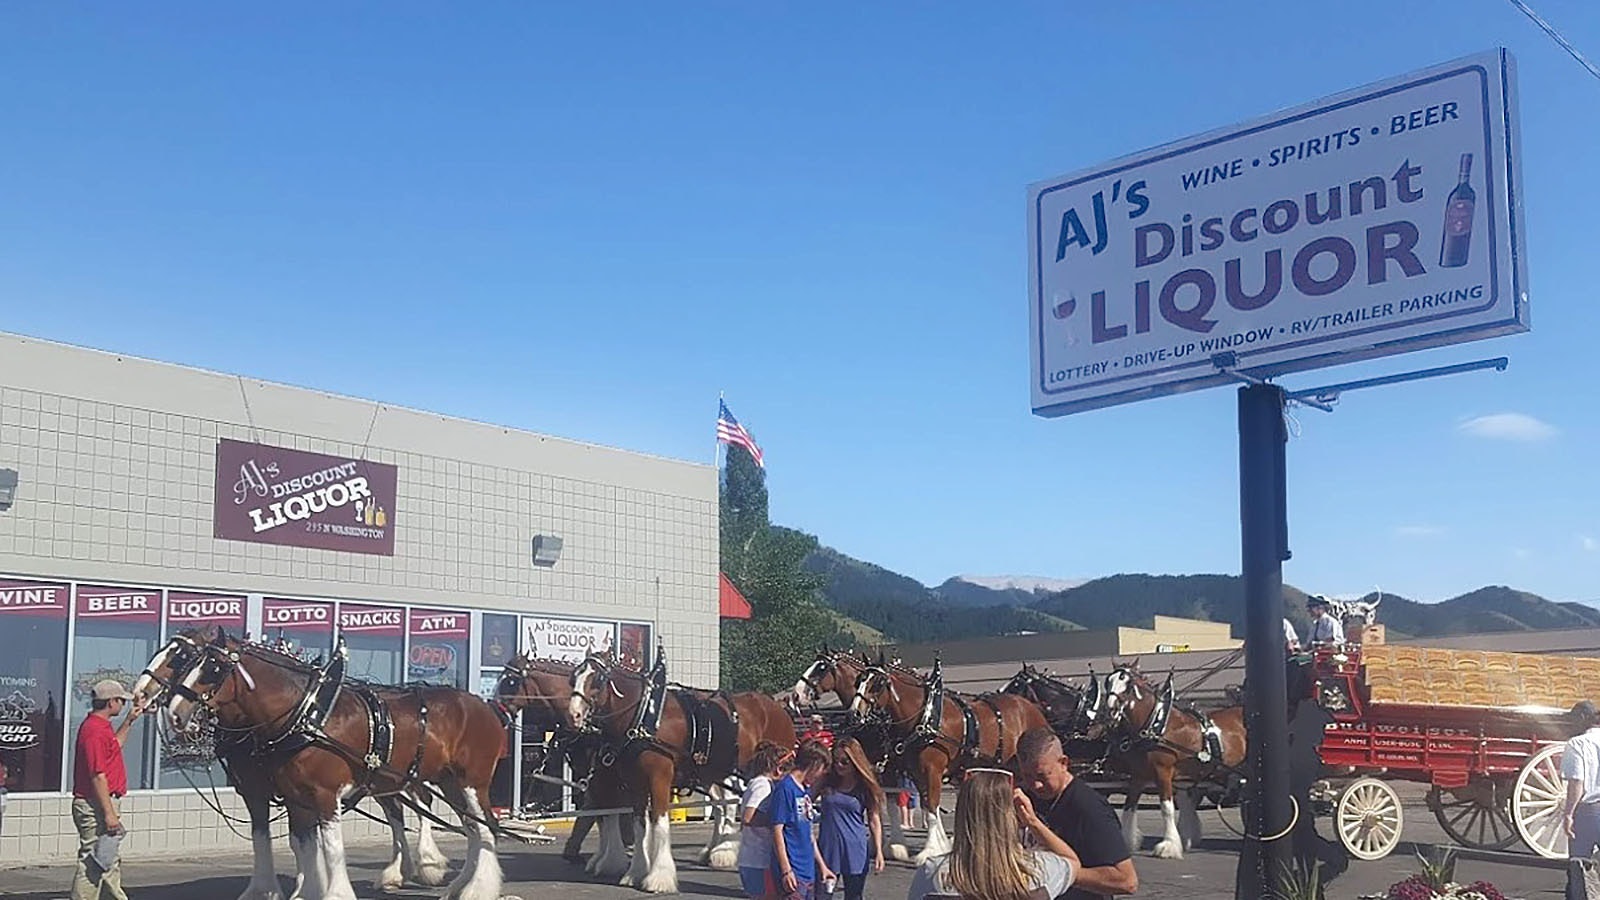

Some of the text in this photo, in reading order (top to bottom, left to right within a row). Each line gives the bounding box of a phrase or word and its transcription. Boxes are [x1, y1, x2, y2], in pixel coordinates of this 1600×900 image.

[1181, 100, 1460, 192] WINE SPIRITS BEER
[1055, 179, 1150, 263] AJ's
[1134, 158, 1425, 268] Discount
[1091, 220, 1427, 344] LIQUOR
[1050, 285, 1484, 384] LOTTERY DRIVE-UP WINDOW RV/TRAILER PARKING
[233, 459, 281, 505] AJ's
[270, 462, 358, 499] DISCOUNT
[248, 476, 373, 533] LIQUOR
[331, 524, 385, 539] WASHINGTON
[88, 595, 148, 612] BEER
[169, 601, 242, 618] LIQUOR
[267, 607, 327, 623] LOTTO
[340, 612, 401, 627] SNACKS
[420, 616, 456, 631] ATM
[552, 623, 594, 634] DISCOUNT
[547, 633, 597, 649] LIQUOR
[410, 645, 453, 665] OPEN
[0, 676, 37, 688] YOMING
